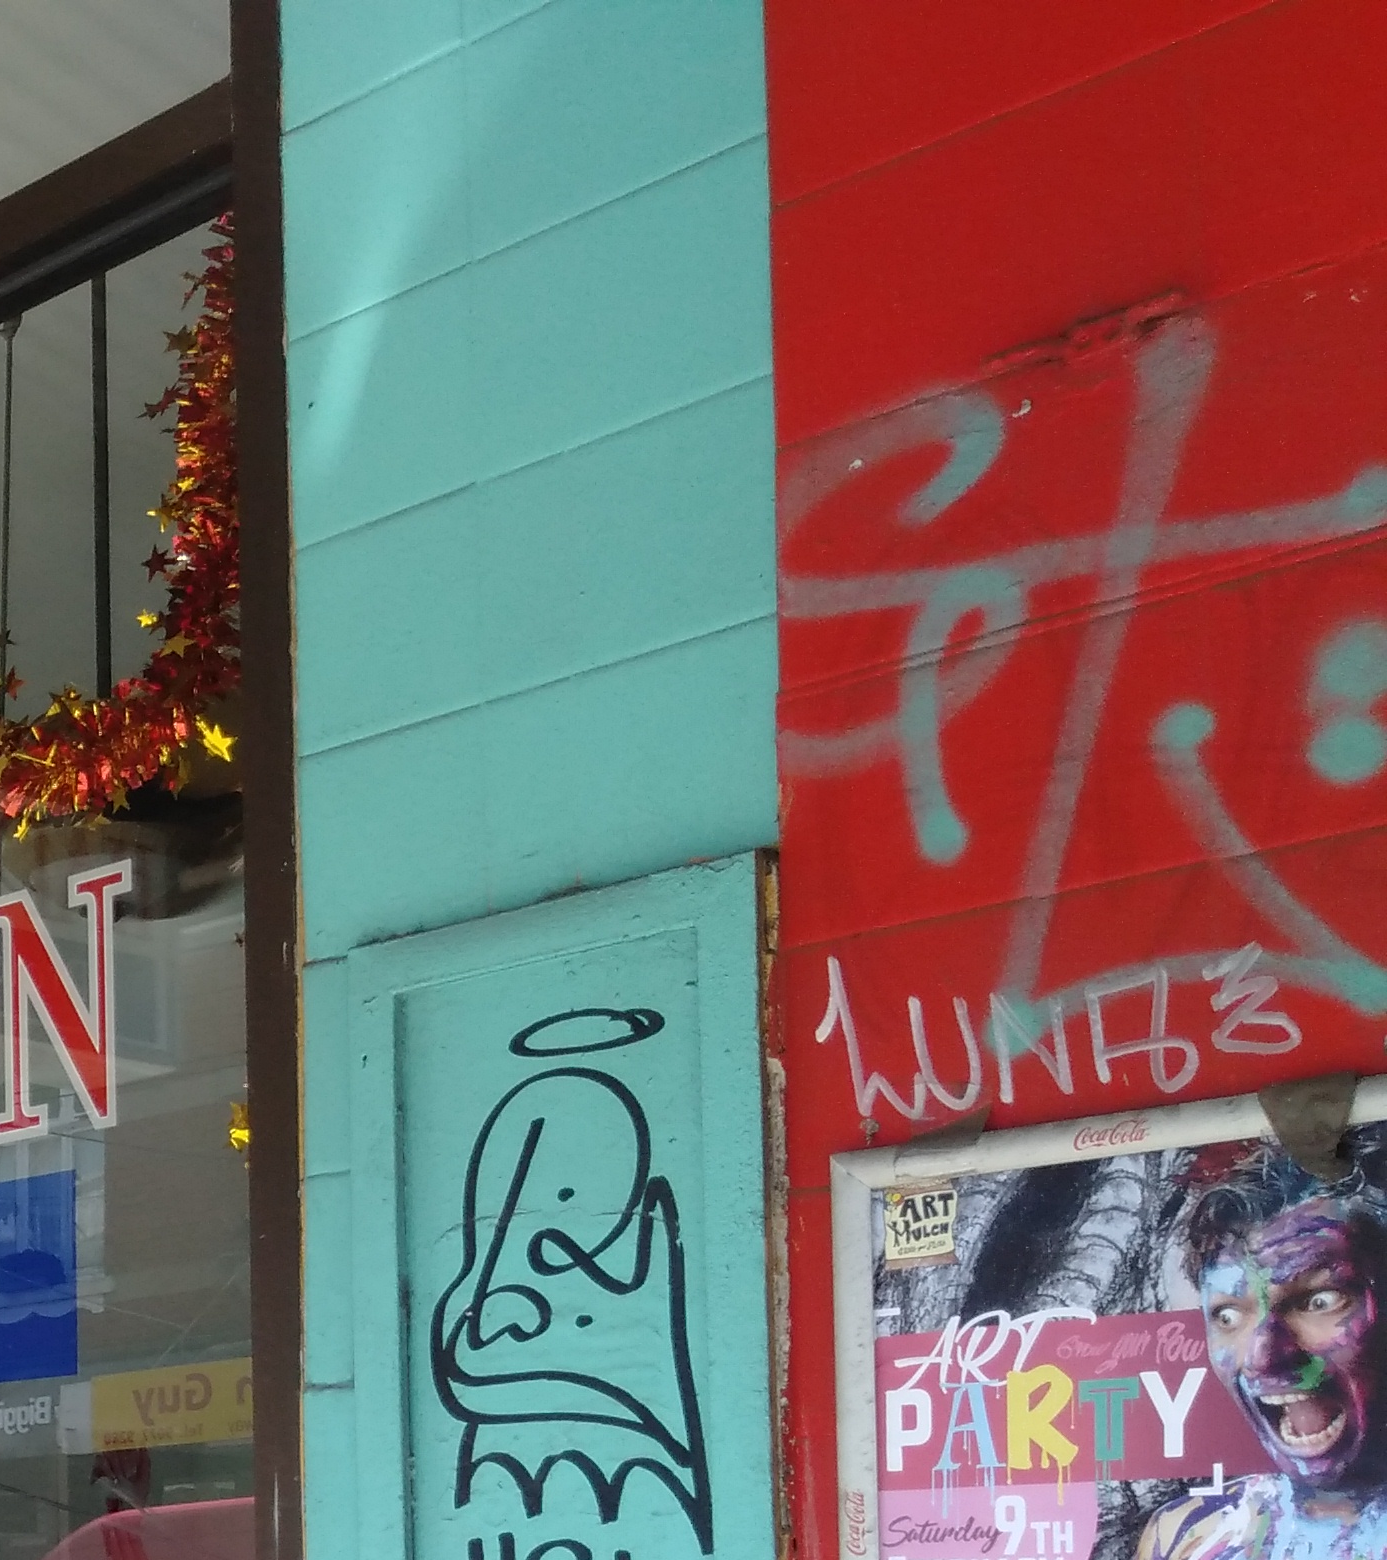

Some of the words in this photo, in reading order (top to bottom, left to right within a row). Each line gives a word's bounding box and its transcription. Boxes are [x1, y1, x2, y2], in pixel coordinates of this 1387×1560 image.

[899, 1192, 954, 1224] ART
[887, 1219, 949, 1247] MULCH
[894, 1307, 1097, 1393] ART
[885, 1364, 1207, 1473] PARTY
[883, 1515, 1003, 1554] Saturday
